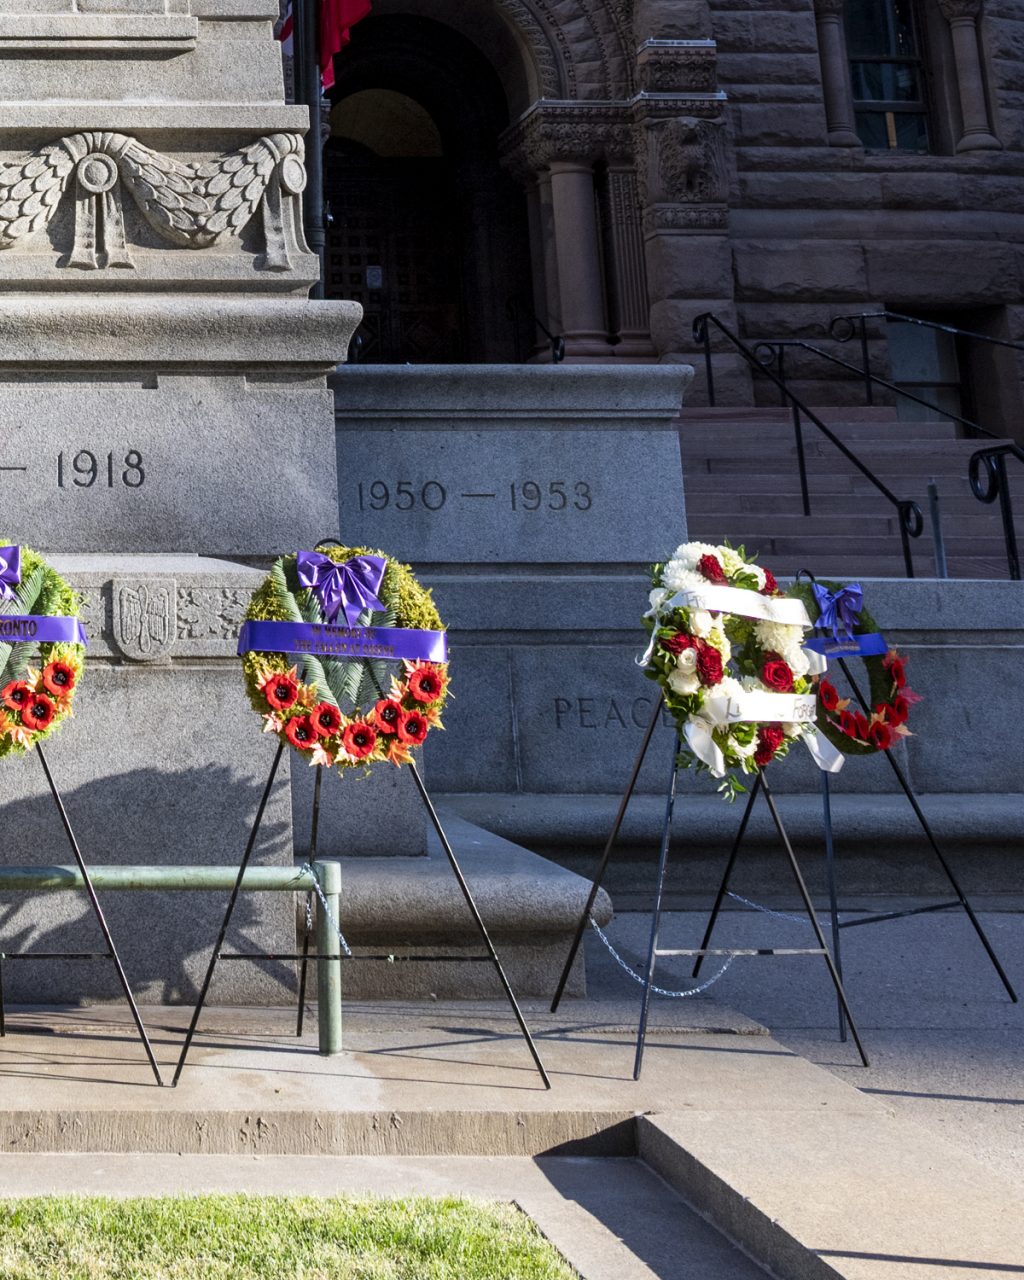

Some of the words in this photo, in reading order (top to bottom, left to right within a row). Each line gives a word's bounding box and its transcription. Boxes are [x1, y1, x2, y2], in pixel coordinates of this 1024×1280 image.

[57, 448, 146, 488] 1918
[357, 480, 447, 511] 1950
[510, 481, 593, 511] 1953
